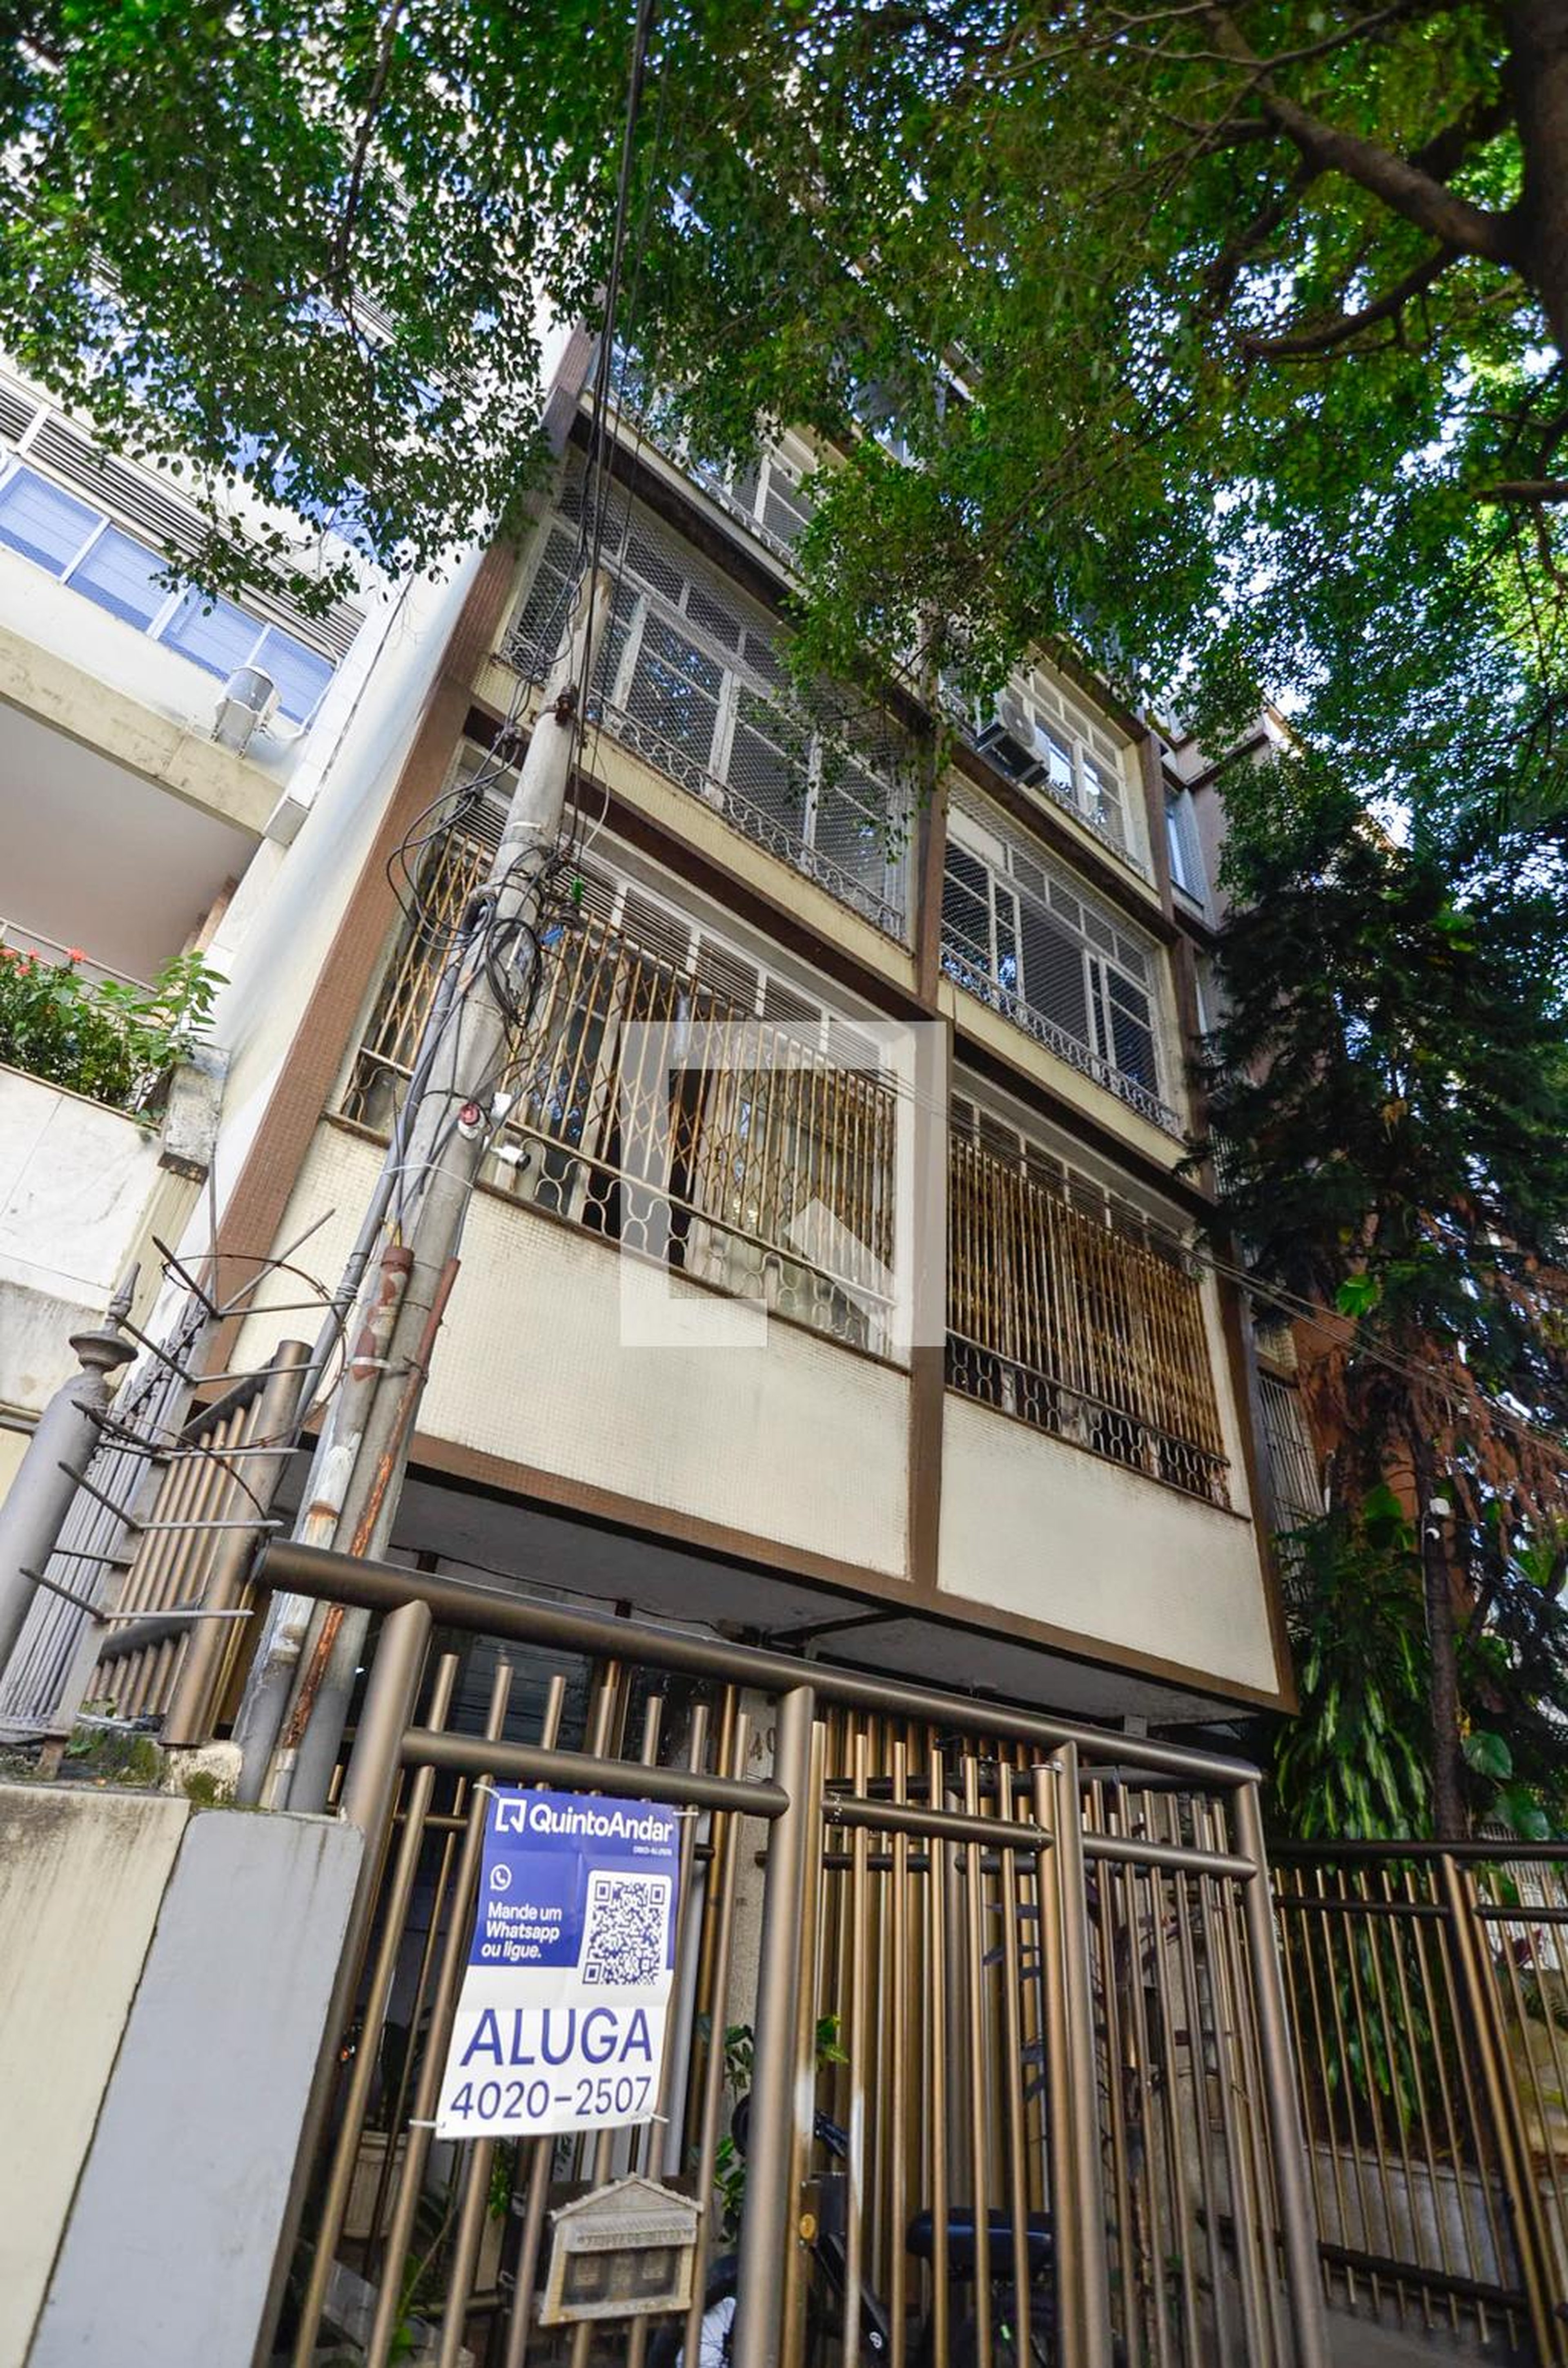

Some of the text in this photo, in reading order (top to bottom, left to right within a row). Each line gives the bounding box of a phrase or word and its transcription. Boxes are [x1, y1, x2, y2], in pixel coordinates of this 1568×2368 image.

[529, 1803, 674, 1843] QuintoAndar
[488, 1901, 562, 1921] Mande um
[486, 1920, 560, 1944] Whatsapp
[481, 1940, 542, 1961] ou ligue.
[459, 2007, 652, 2067] ALUGA
[450, 2076, 652, 2120] 4020-2507
